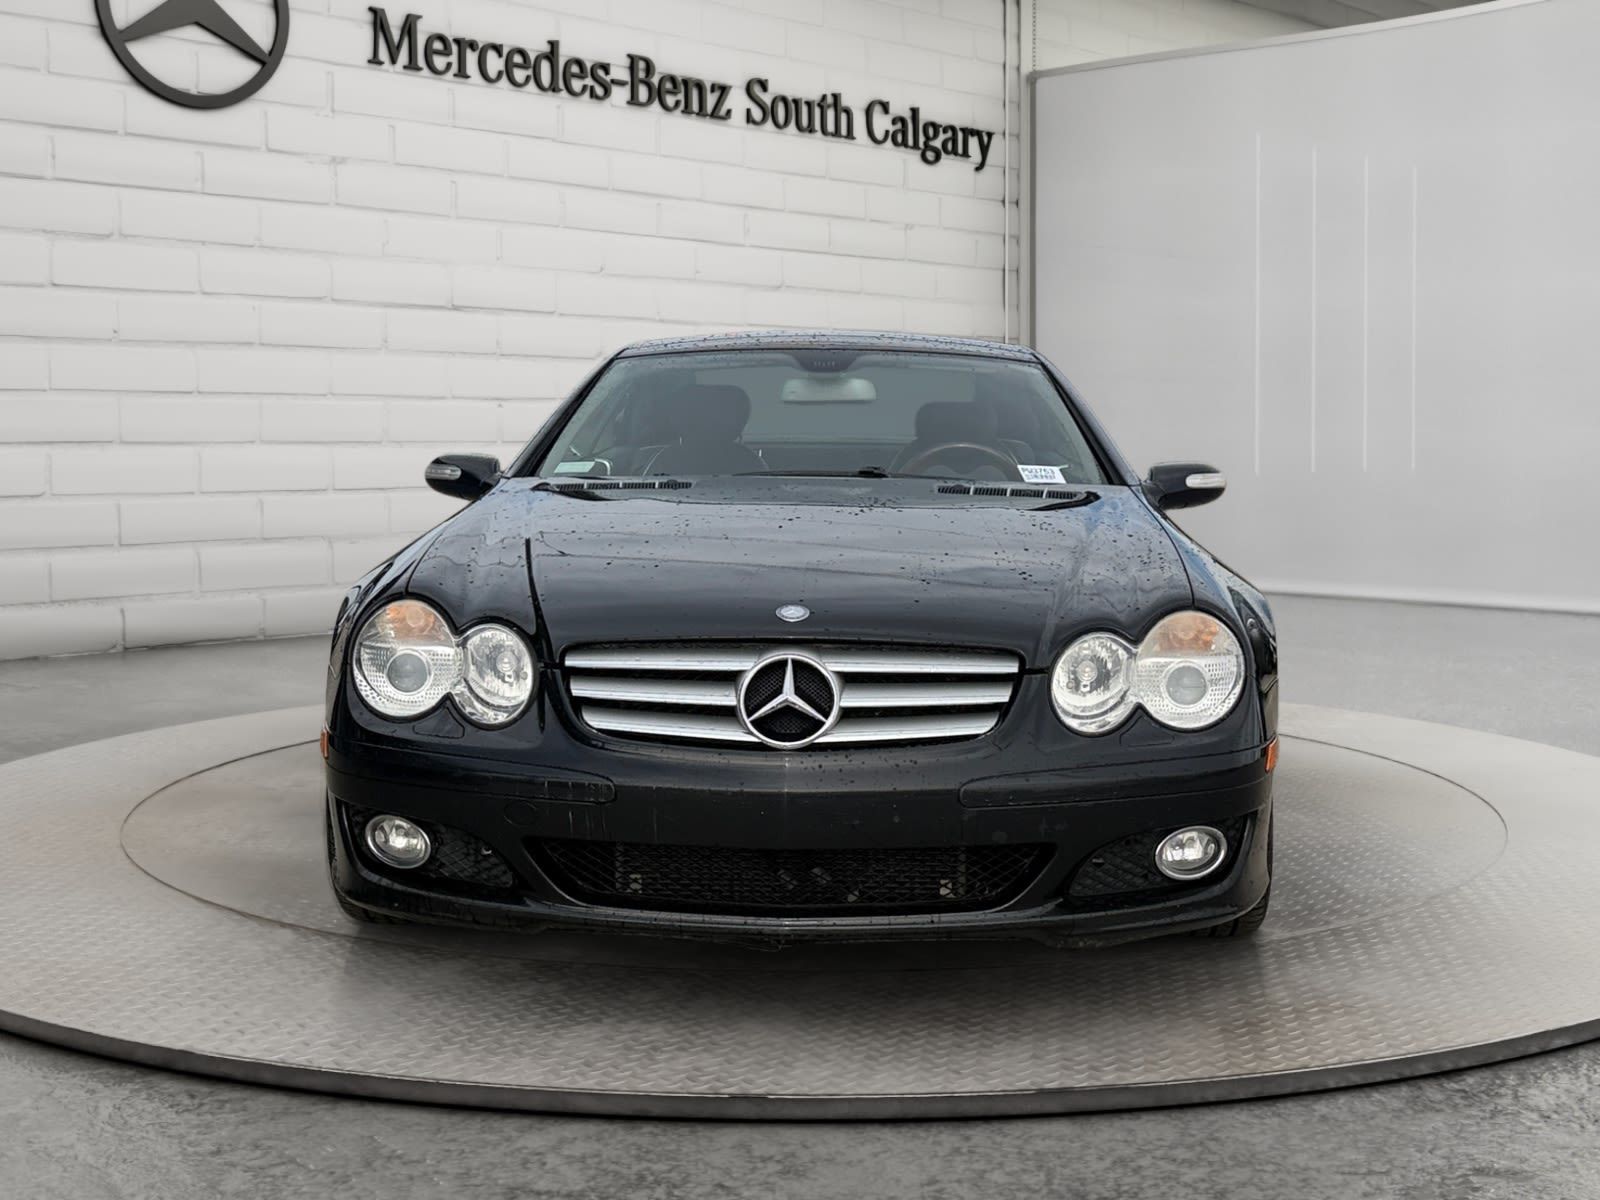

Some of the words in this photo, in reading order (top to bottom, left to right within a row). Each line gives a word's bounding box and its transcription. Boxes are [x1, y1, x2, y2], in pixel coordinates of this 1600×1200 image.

[367, 6, 732, 121] Mercedes-Benz
[745, 78, 856, 140] South
[865, 100, 995, 172] Calgary
